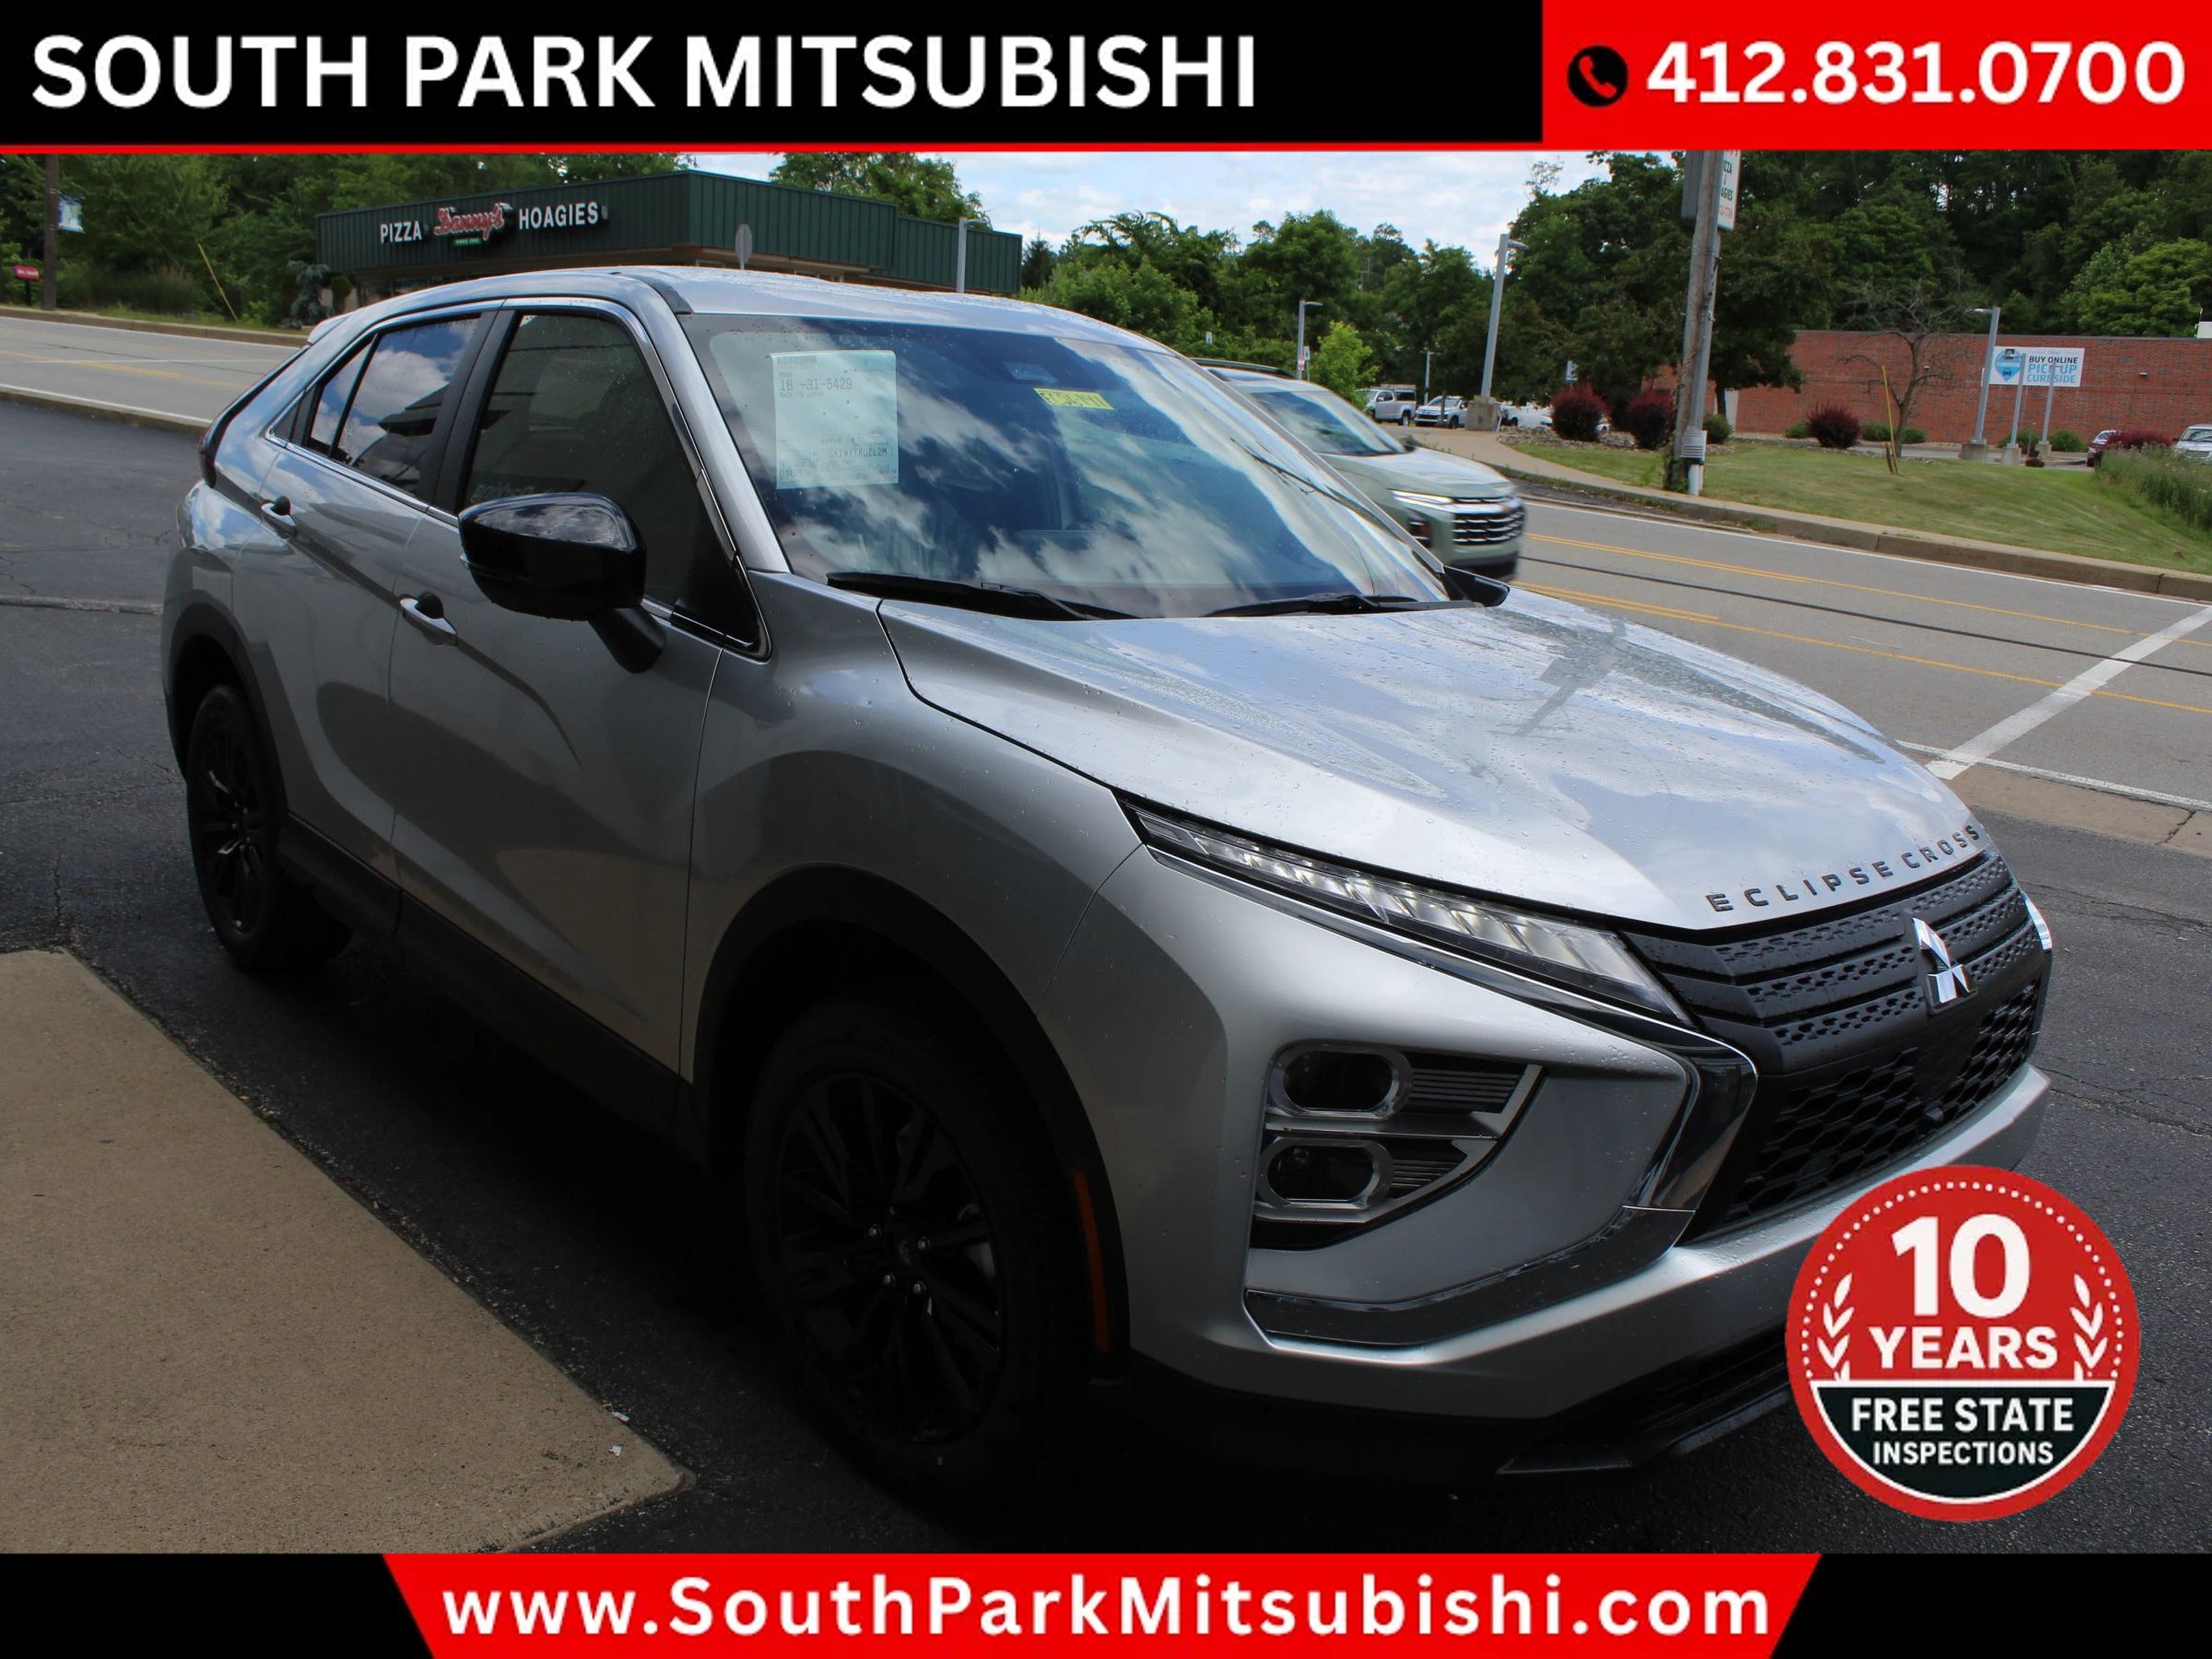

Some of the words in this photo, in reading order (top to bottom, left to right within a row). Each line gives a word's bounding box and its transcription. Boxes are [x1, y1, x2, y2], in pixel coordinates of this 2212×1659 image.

[380, 220, 422, 243] PIZZA
[519, 201, 599, 229] HOAGIES
[2047, 356, 2078, 364] ONLINE
[1705, 860, 1893, 912] ECLIPSE
[1900, 825, 1980, 869] CROSS
